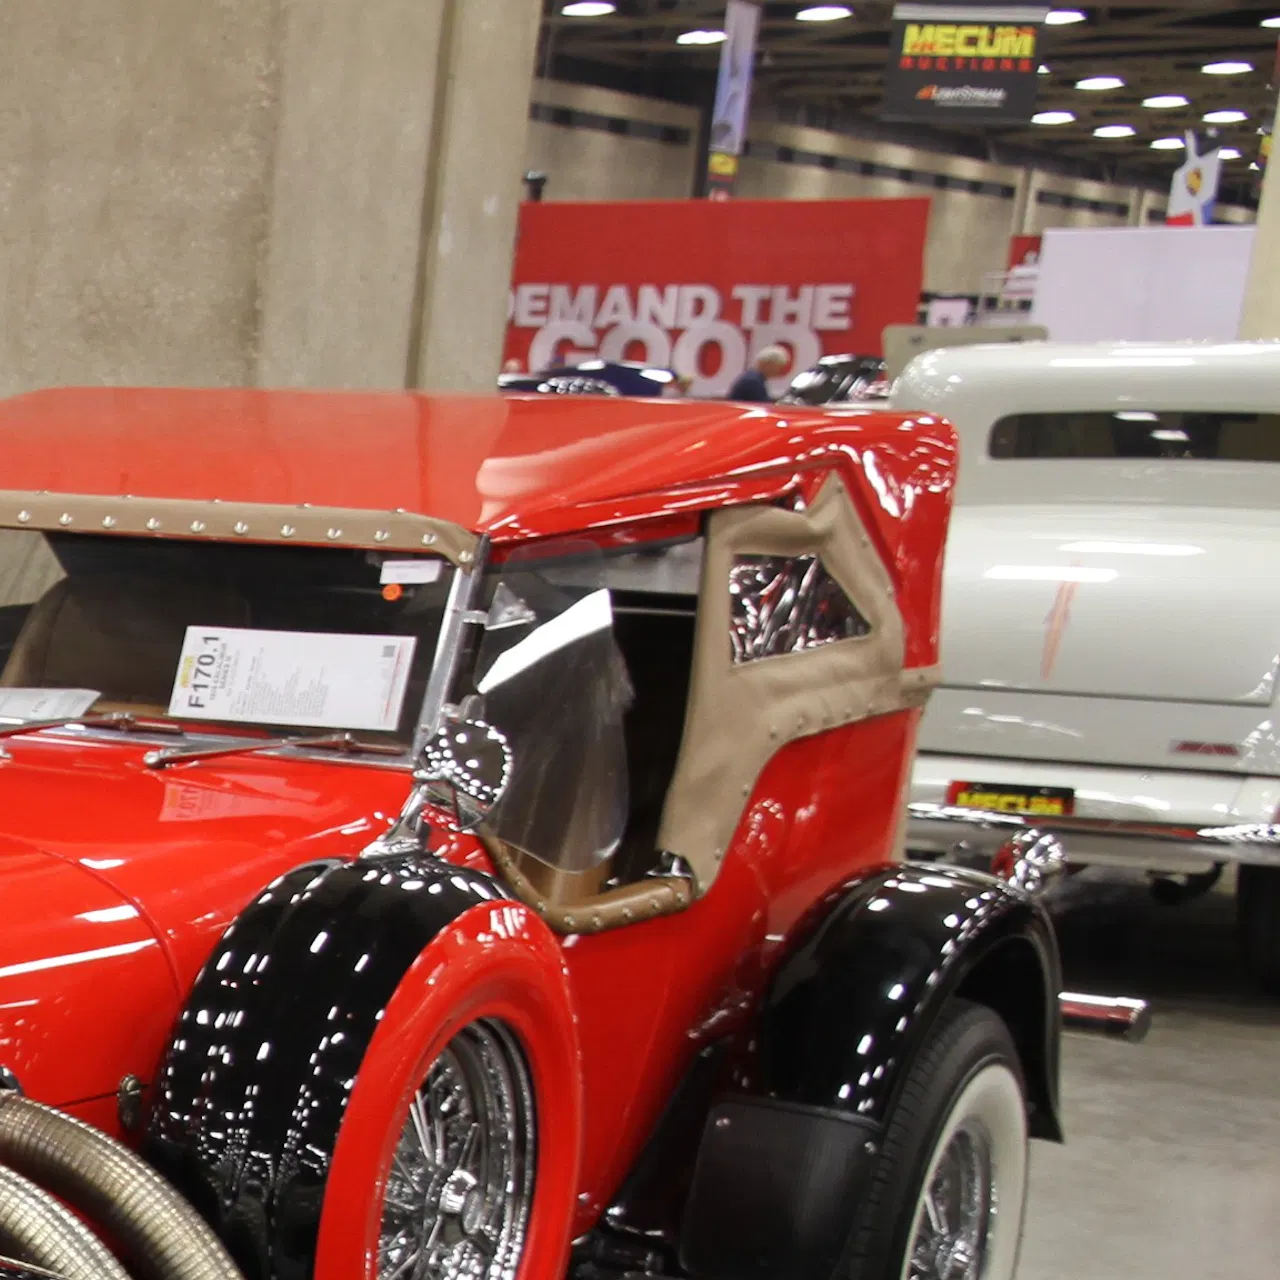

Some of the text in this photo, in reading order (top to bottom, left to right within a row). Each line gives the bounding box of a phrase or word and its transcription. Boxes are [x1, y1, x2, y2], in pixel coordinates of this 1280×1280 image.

[902, 24, 1037, 58] MECUM
[732, 283, 855, 331] THE
[188, 636, 219, 708] F170.1
